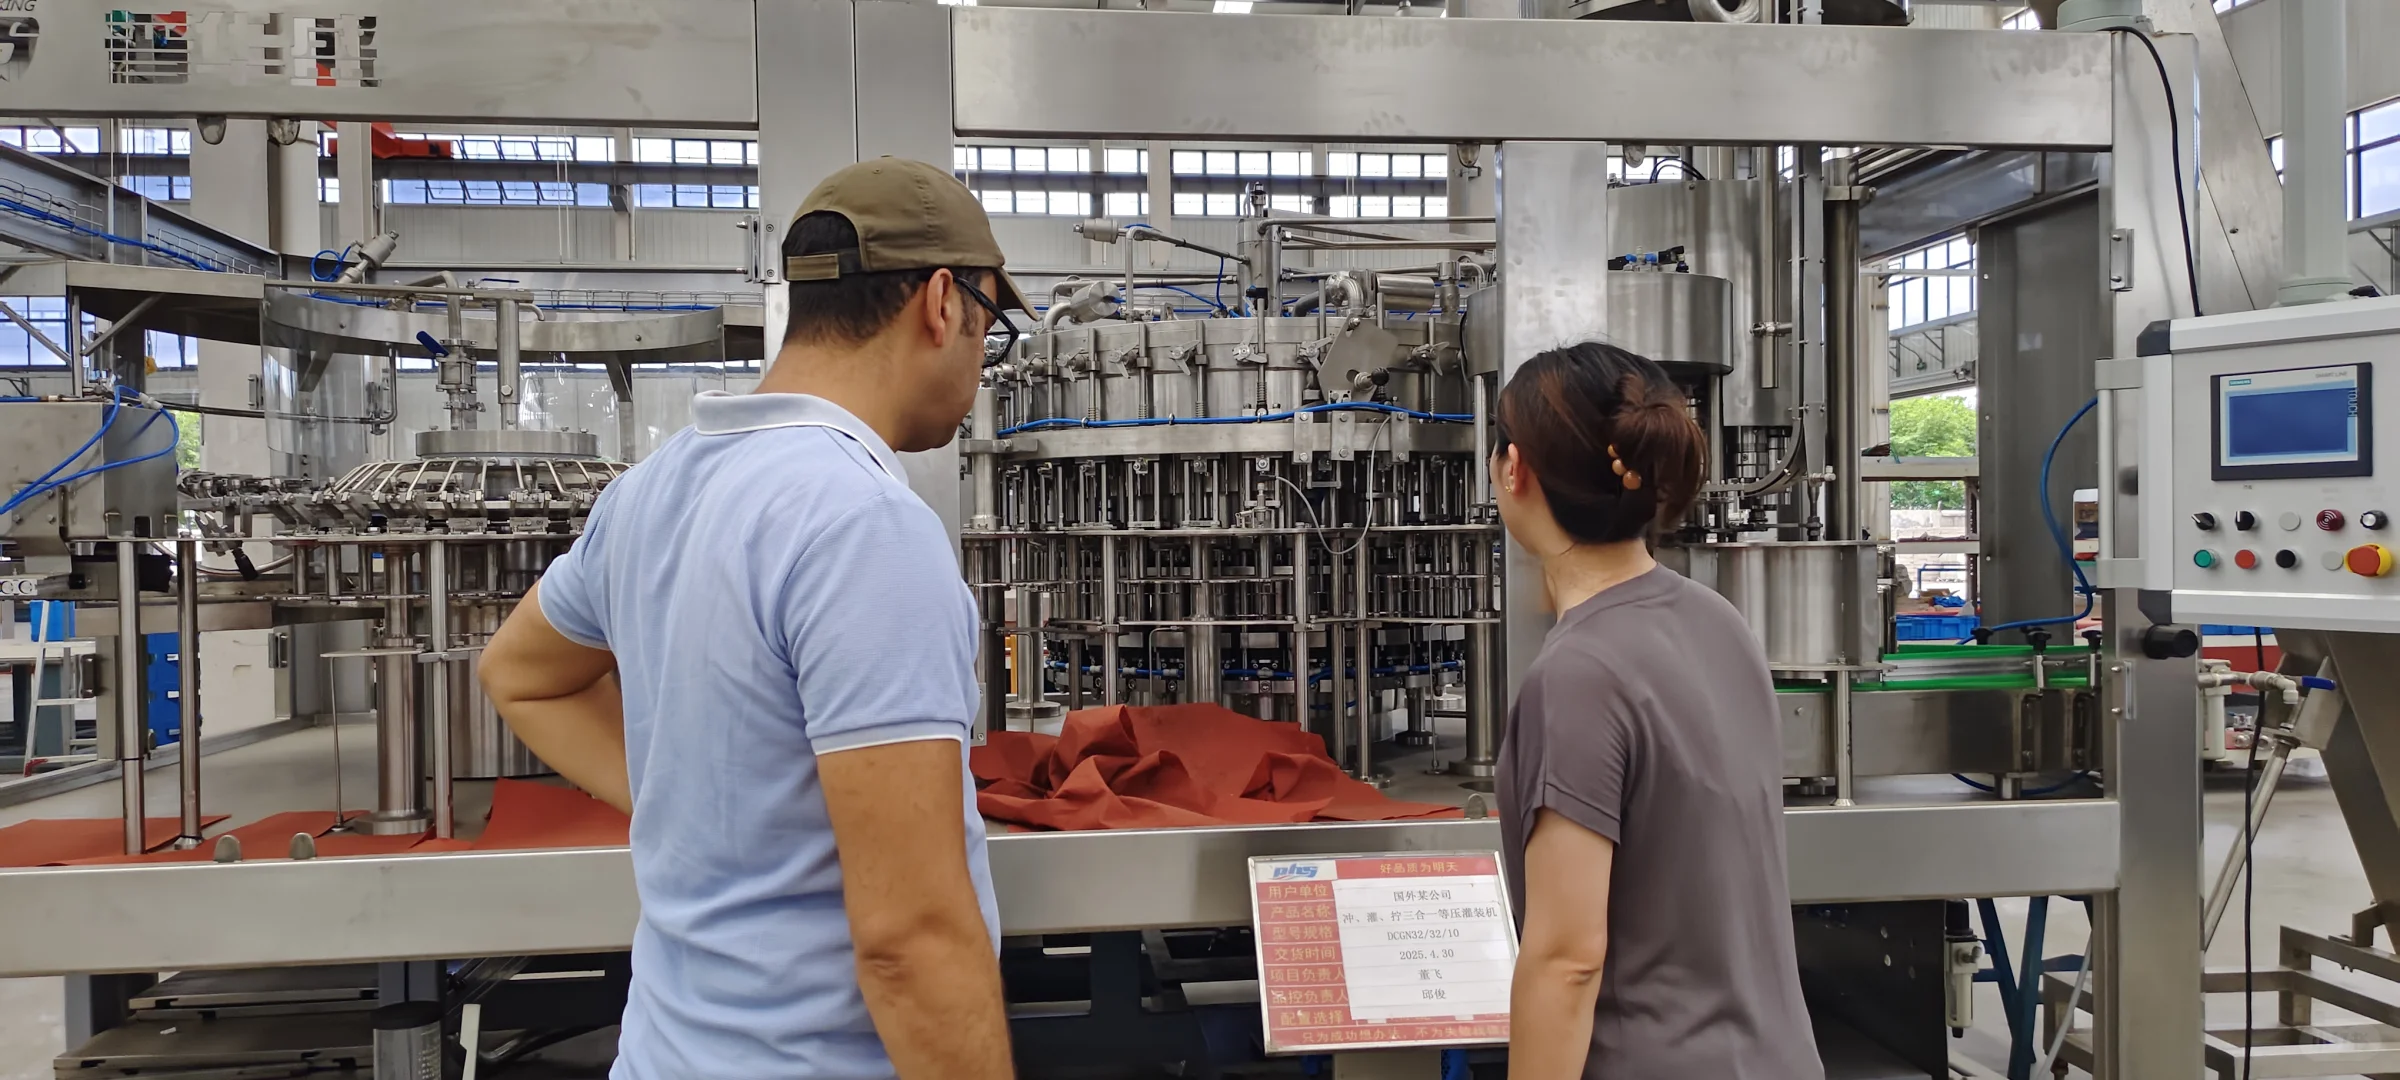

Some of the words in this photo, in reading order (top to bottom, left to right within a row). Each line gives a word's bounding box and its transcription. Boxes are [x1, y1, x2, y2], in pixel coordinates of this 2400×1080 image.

[2347, 388, 2358, 417] TOUCH
[1380, 861, 1458, 874] 好品质为明天
[1269, 884, 1328, 899] 用户单位
[1393, 889, 1452, 902] 国外某公司
[1270, 904, 1331, 919] 产品名称
[1272, 925, 1333, 940] 型号规格
[1387, 928, 1460, 941] DCGN32/32/10
[1275, 946, 1336, 961] 交货时间
[1399, 948, 1454, 960] 2025.4.30
[1270, 967, 1345, 982] 项目负责人
[1418, 968, 1443, 980] 董飞
[1271, 989, 1349, 1005] 品控负责人
[1280, 1010, 1345, 1026] 配置选择
